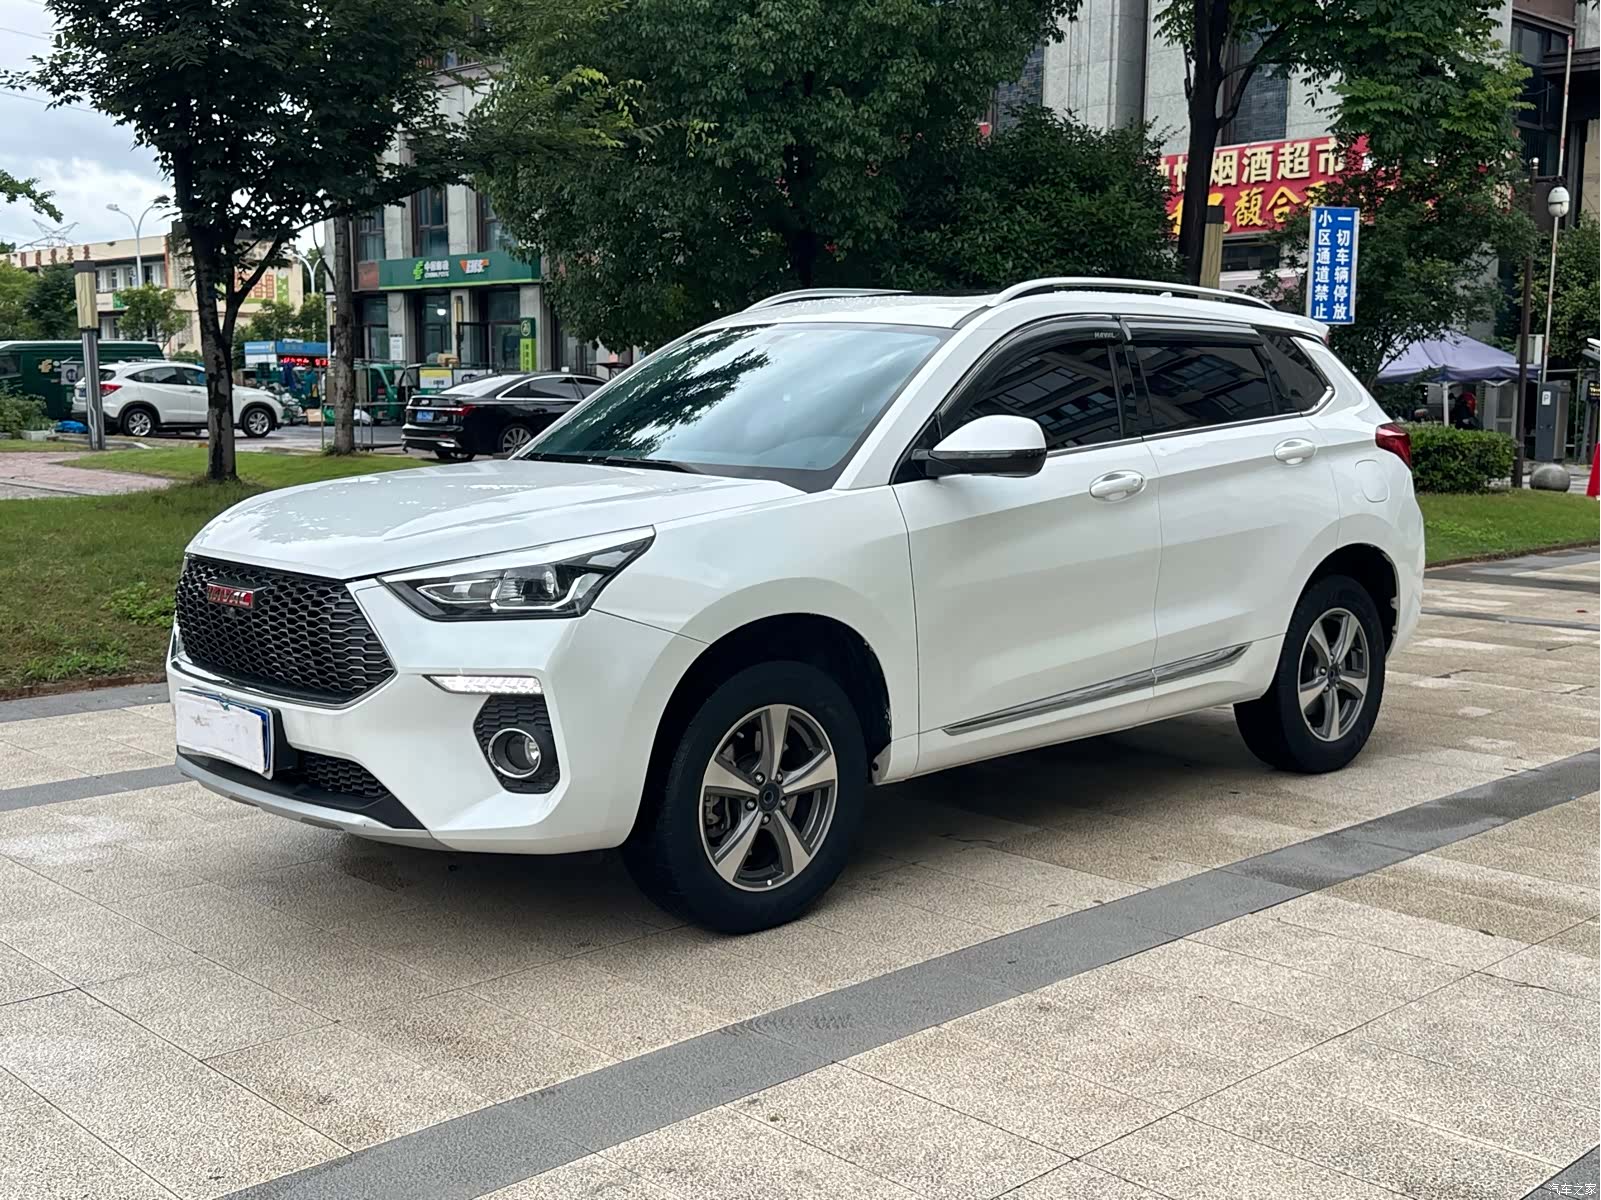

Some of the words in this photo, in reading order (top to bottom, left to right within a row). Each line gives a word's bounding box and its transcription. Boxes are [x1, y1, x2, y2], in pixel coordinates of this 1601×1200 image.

[1156, 139, 1346, 192] 烟酒超市
[1313, 210, 1333, 320] 小区通道禁止
[1333, 216, 1352, 320] 一切车辆停放
